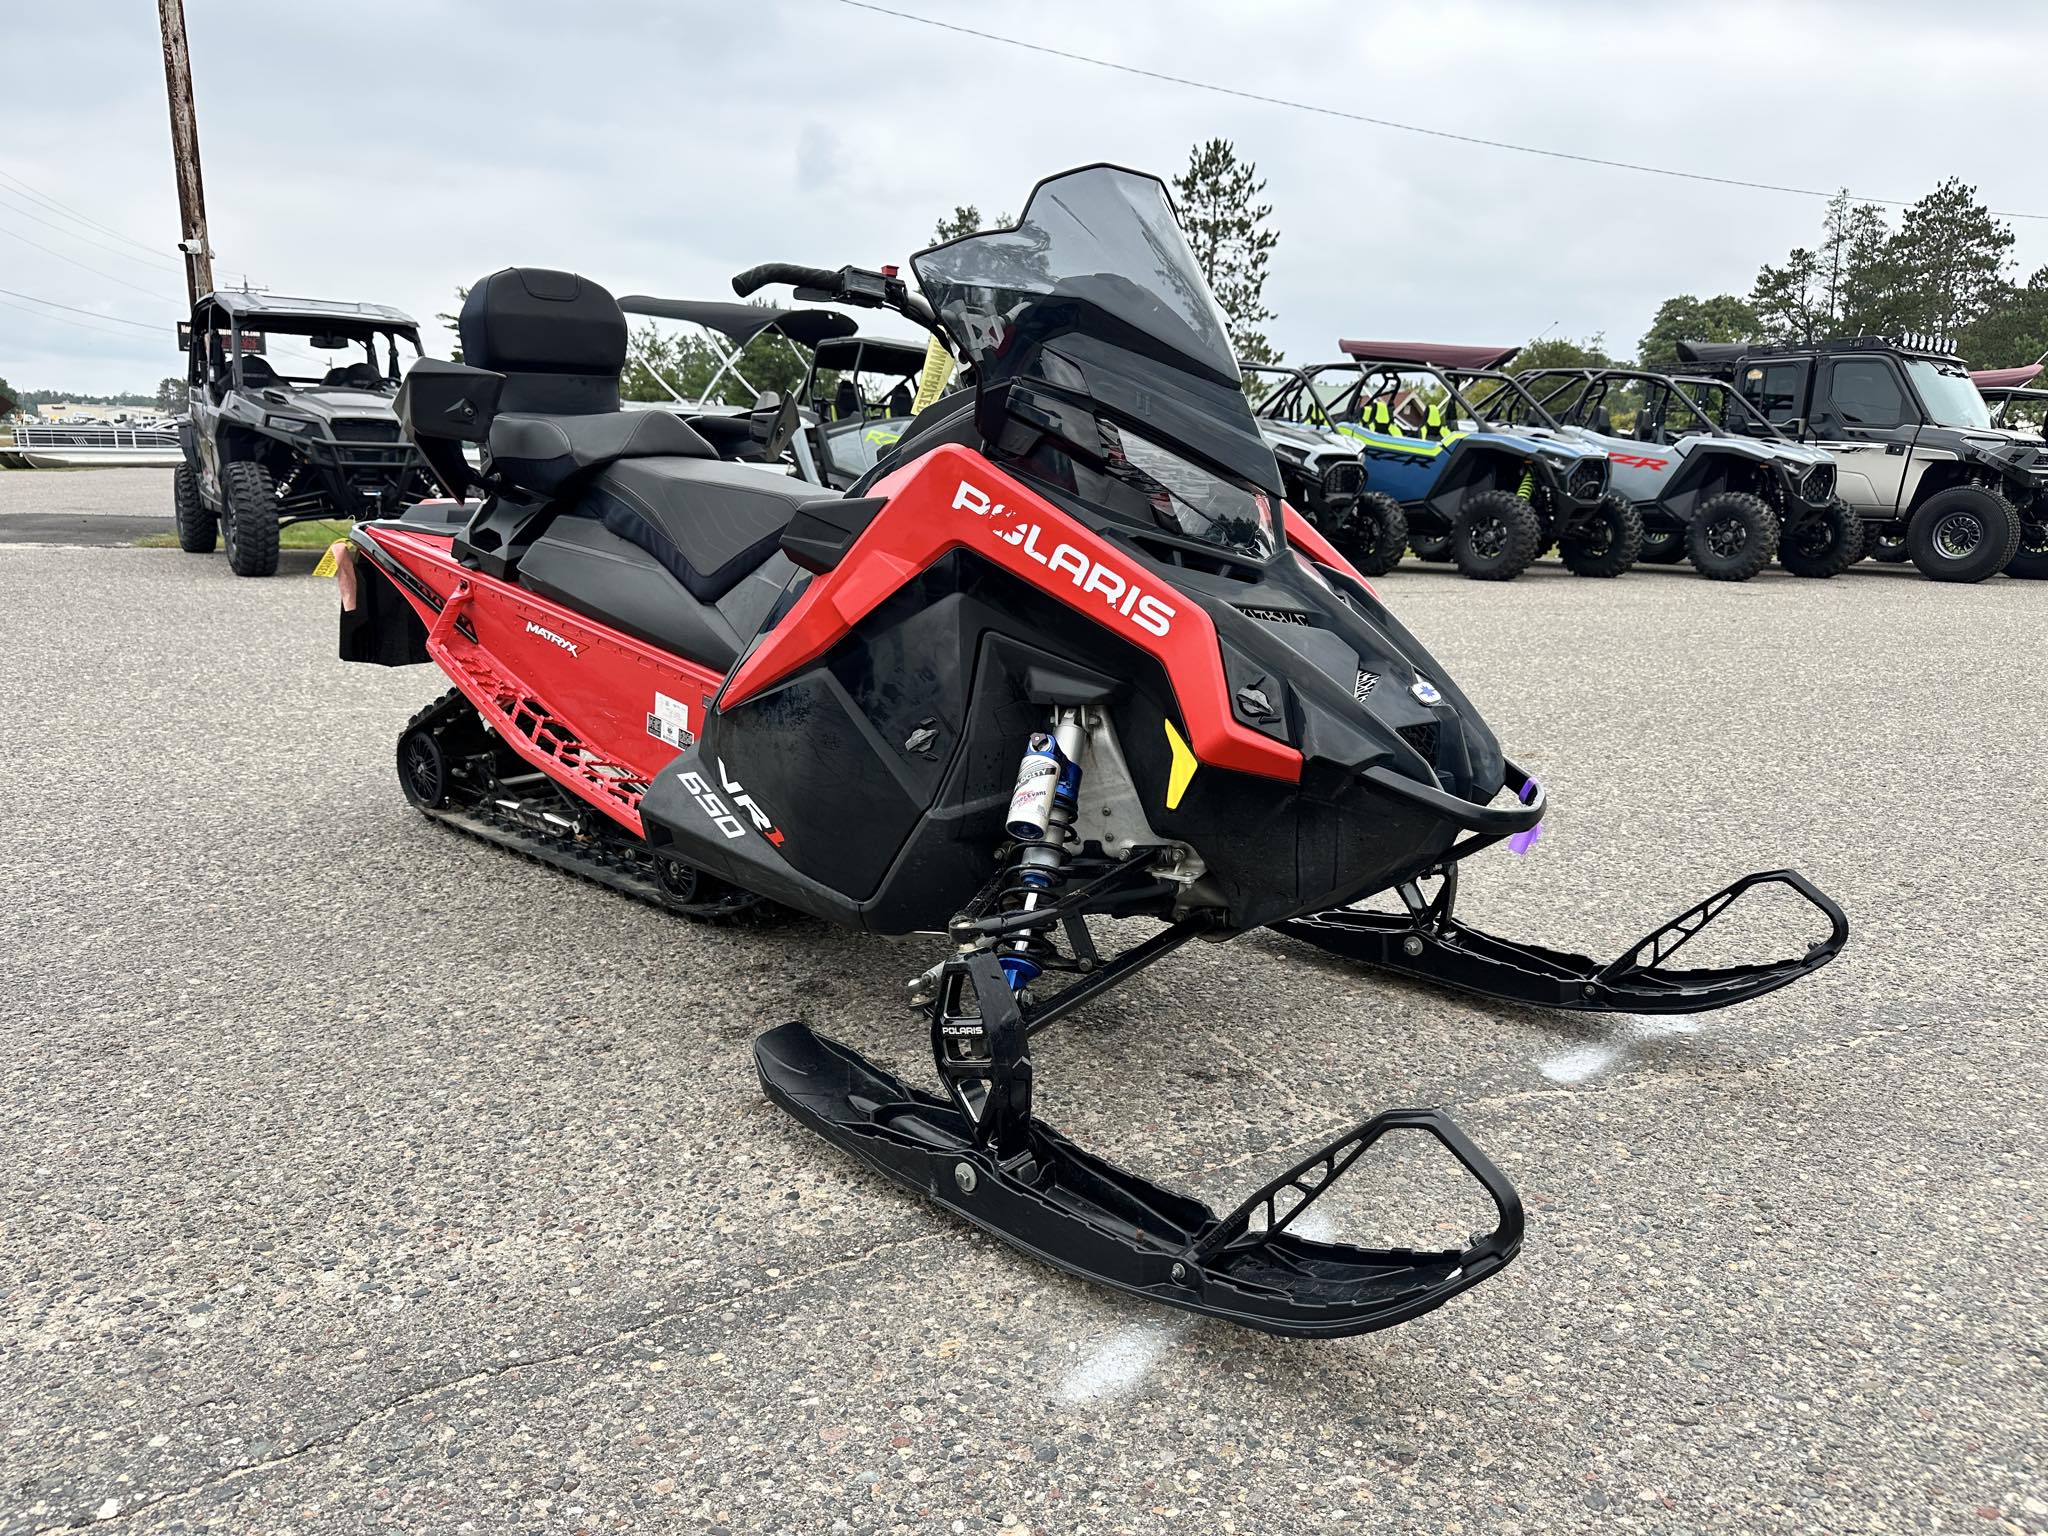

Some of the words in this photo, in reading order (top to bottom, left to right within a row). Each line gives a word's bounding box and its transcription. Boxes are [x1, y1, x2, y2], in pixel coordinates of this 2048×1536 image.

[865, 429, 900, 446] RZ
[1608, 452, 1670, 471] ZR
[952, 480, 1177, 637] POLARIS
[525, 621, 578, 658] MATRYX
[676, 771, 746, 839] 650
[717, 756, 785, 848] VR1
[942, 1026, 984, 1035] POLARIS
